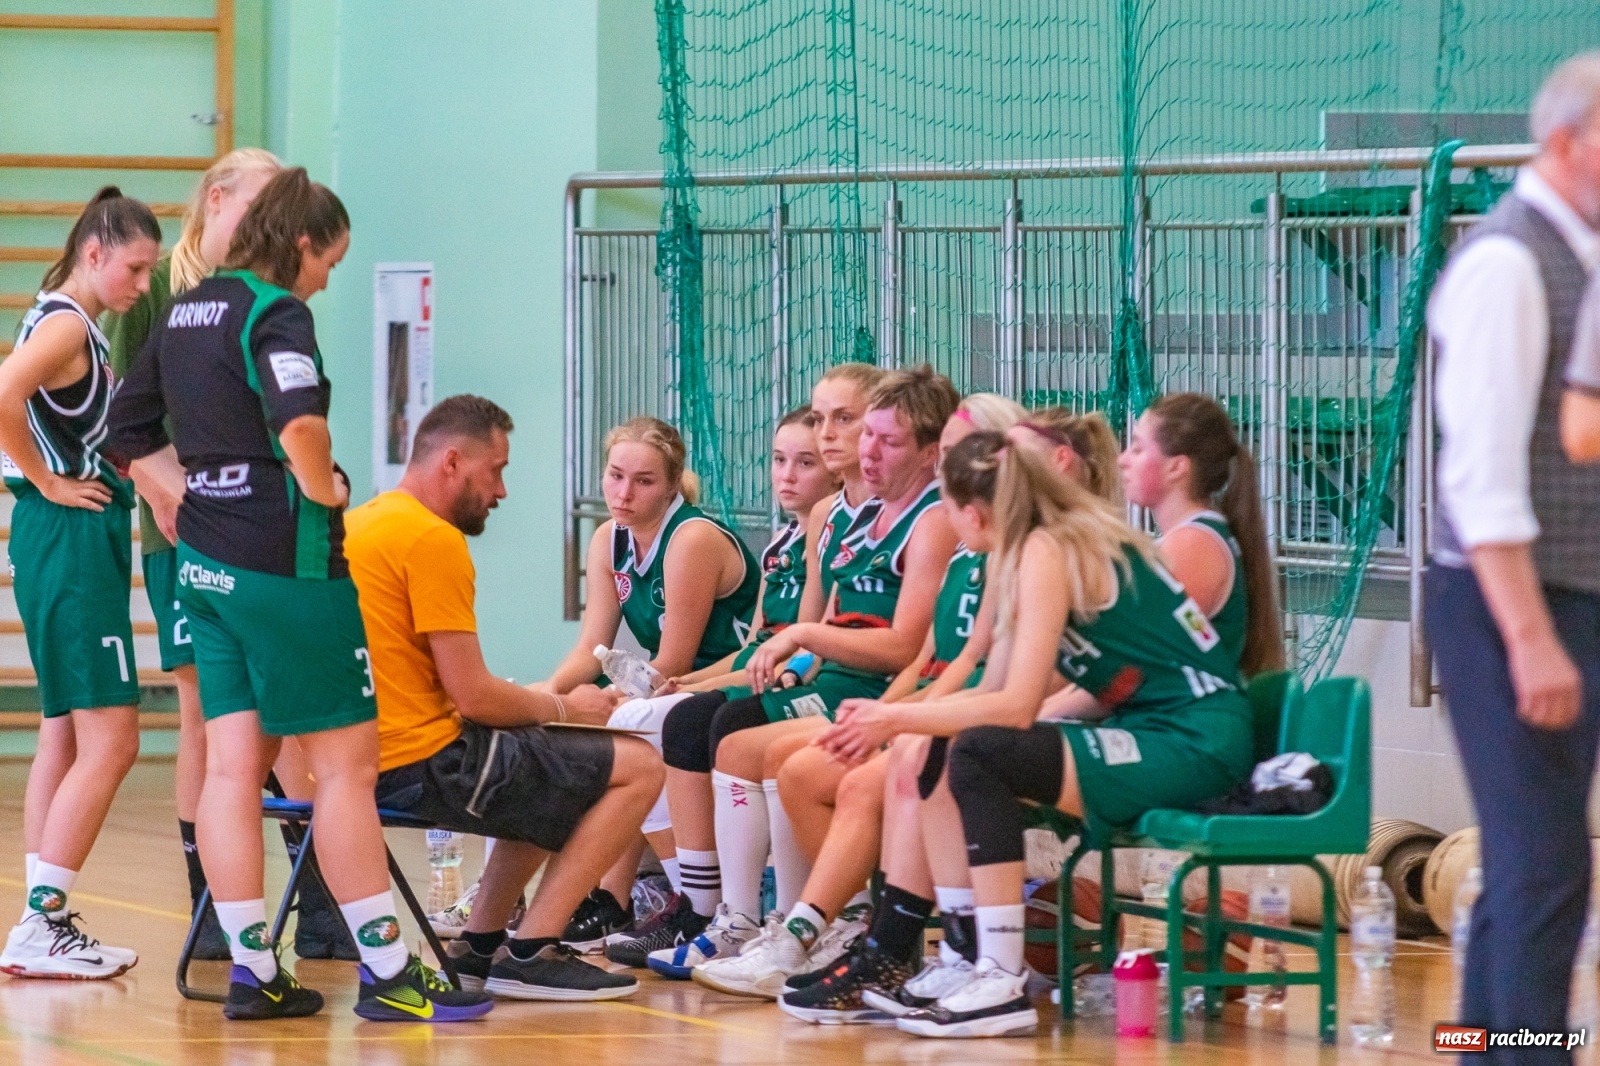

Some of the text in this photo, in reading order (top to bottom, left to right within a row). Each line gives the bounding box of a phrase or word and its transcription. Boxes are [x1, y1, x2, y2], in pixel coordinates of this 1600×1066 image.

[167, 301, 229, 328] KARWOT
[189, 564, 236, 591] Clavis
[955, 593, 979, 637] 5
[101, 635, 129, 682] 7
[354, 647, 376, 697] 3
